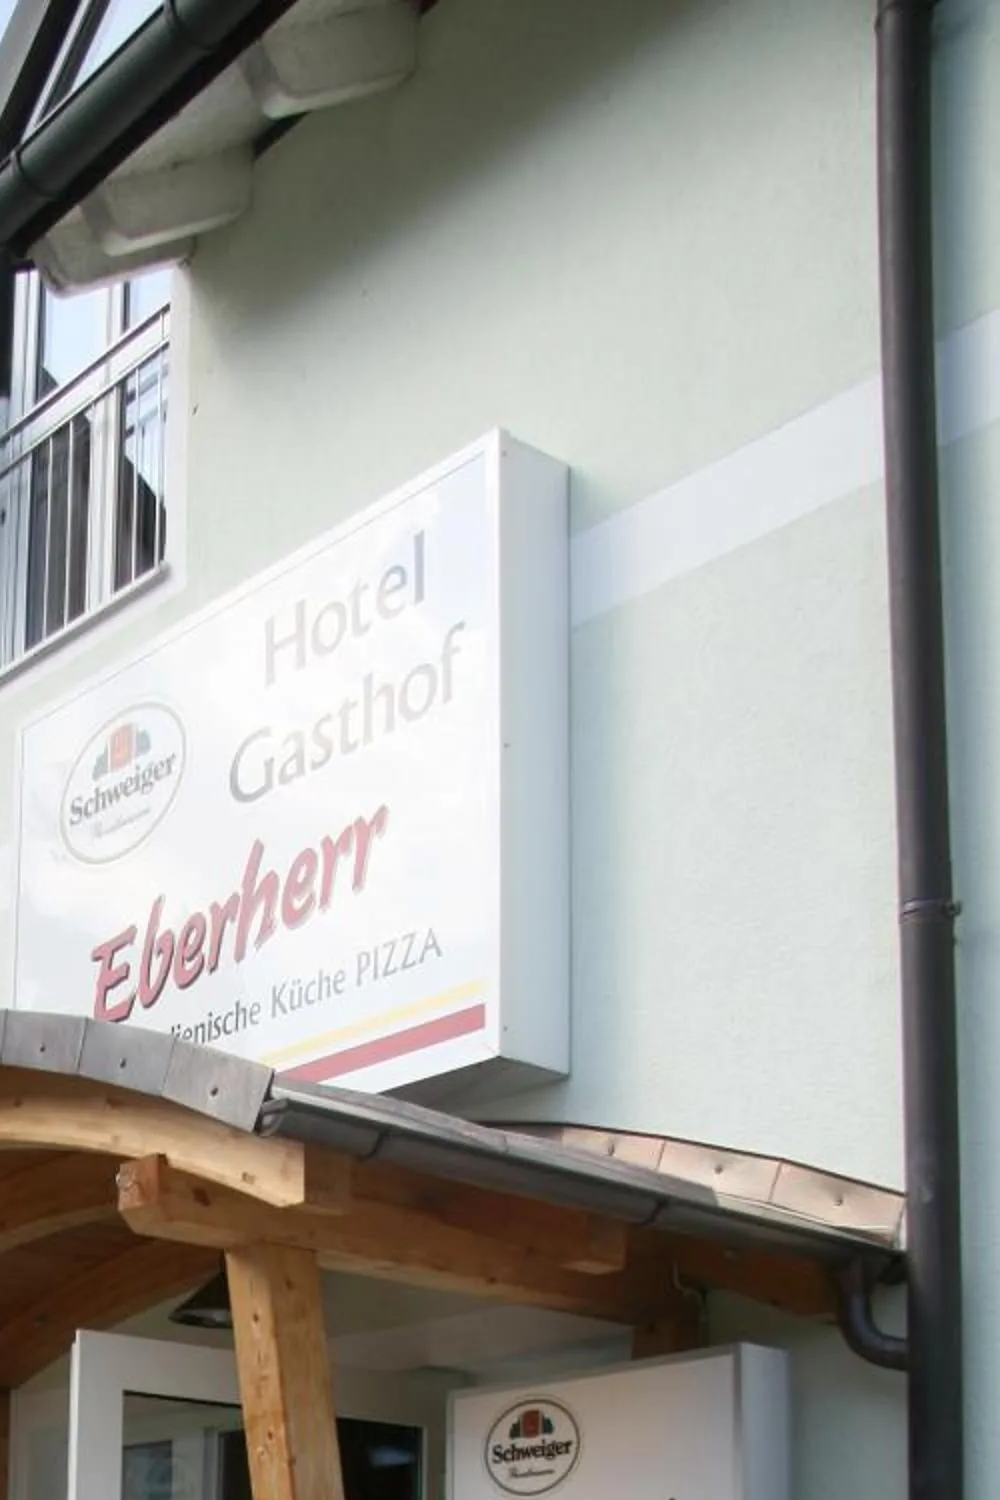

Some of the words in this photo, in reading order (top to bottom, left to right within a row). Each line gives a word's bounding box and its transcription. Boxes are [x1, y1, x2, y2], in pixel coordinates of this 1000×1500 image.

[263, 529, 425, 688] Hotel
[228, 619, 467, 804] Gasthof
[69, 753, 176, 827] Schweiger
[91, 803, 390, 1022] Eberherr
[270, 968, 347, 1018] Küche
[355, 927, 444, 987] PIZZA
[491, 1439, 572, 1464] Schweiger
